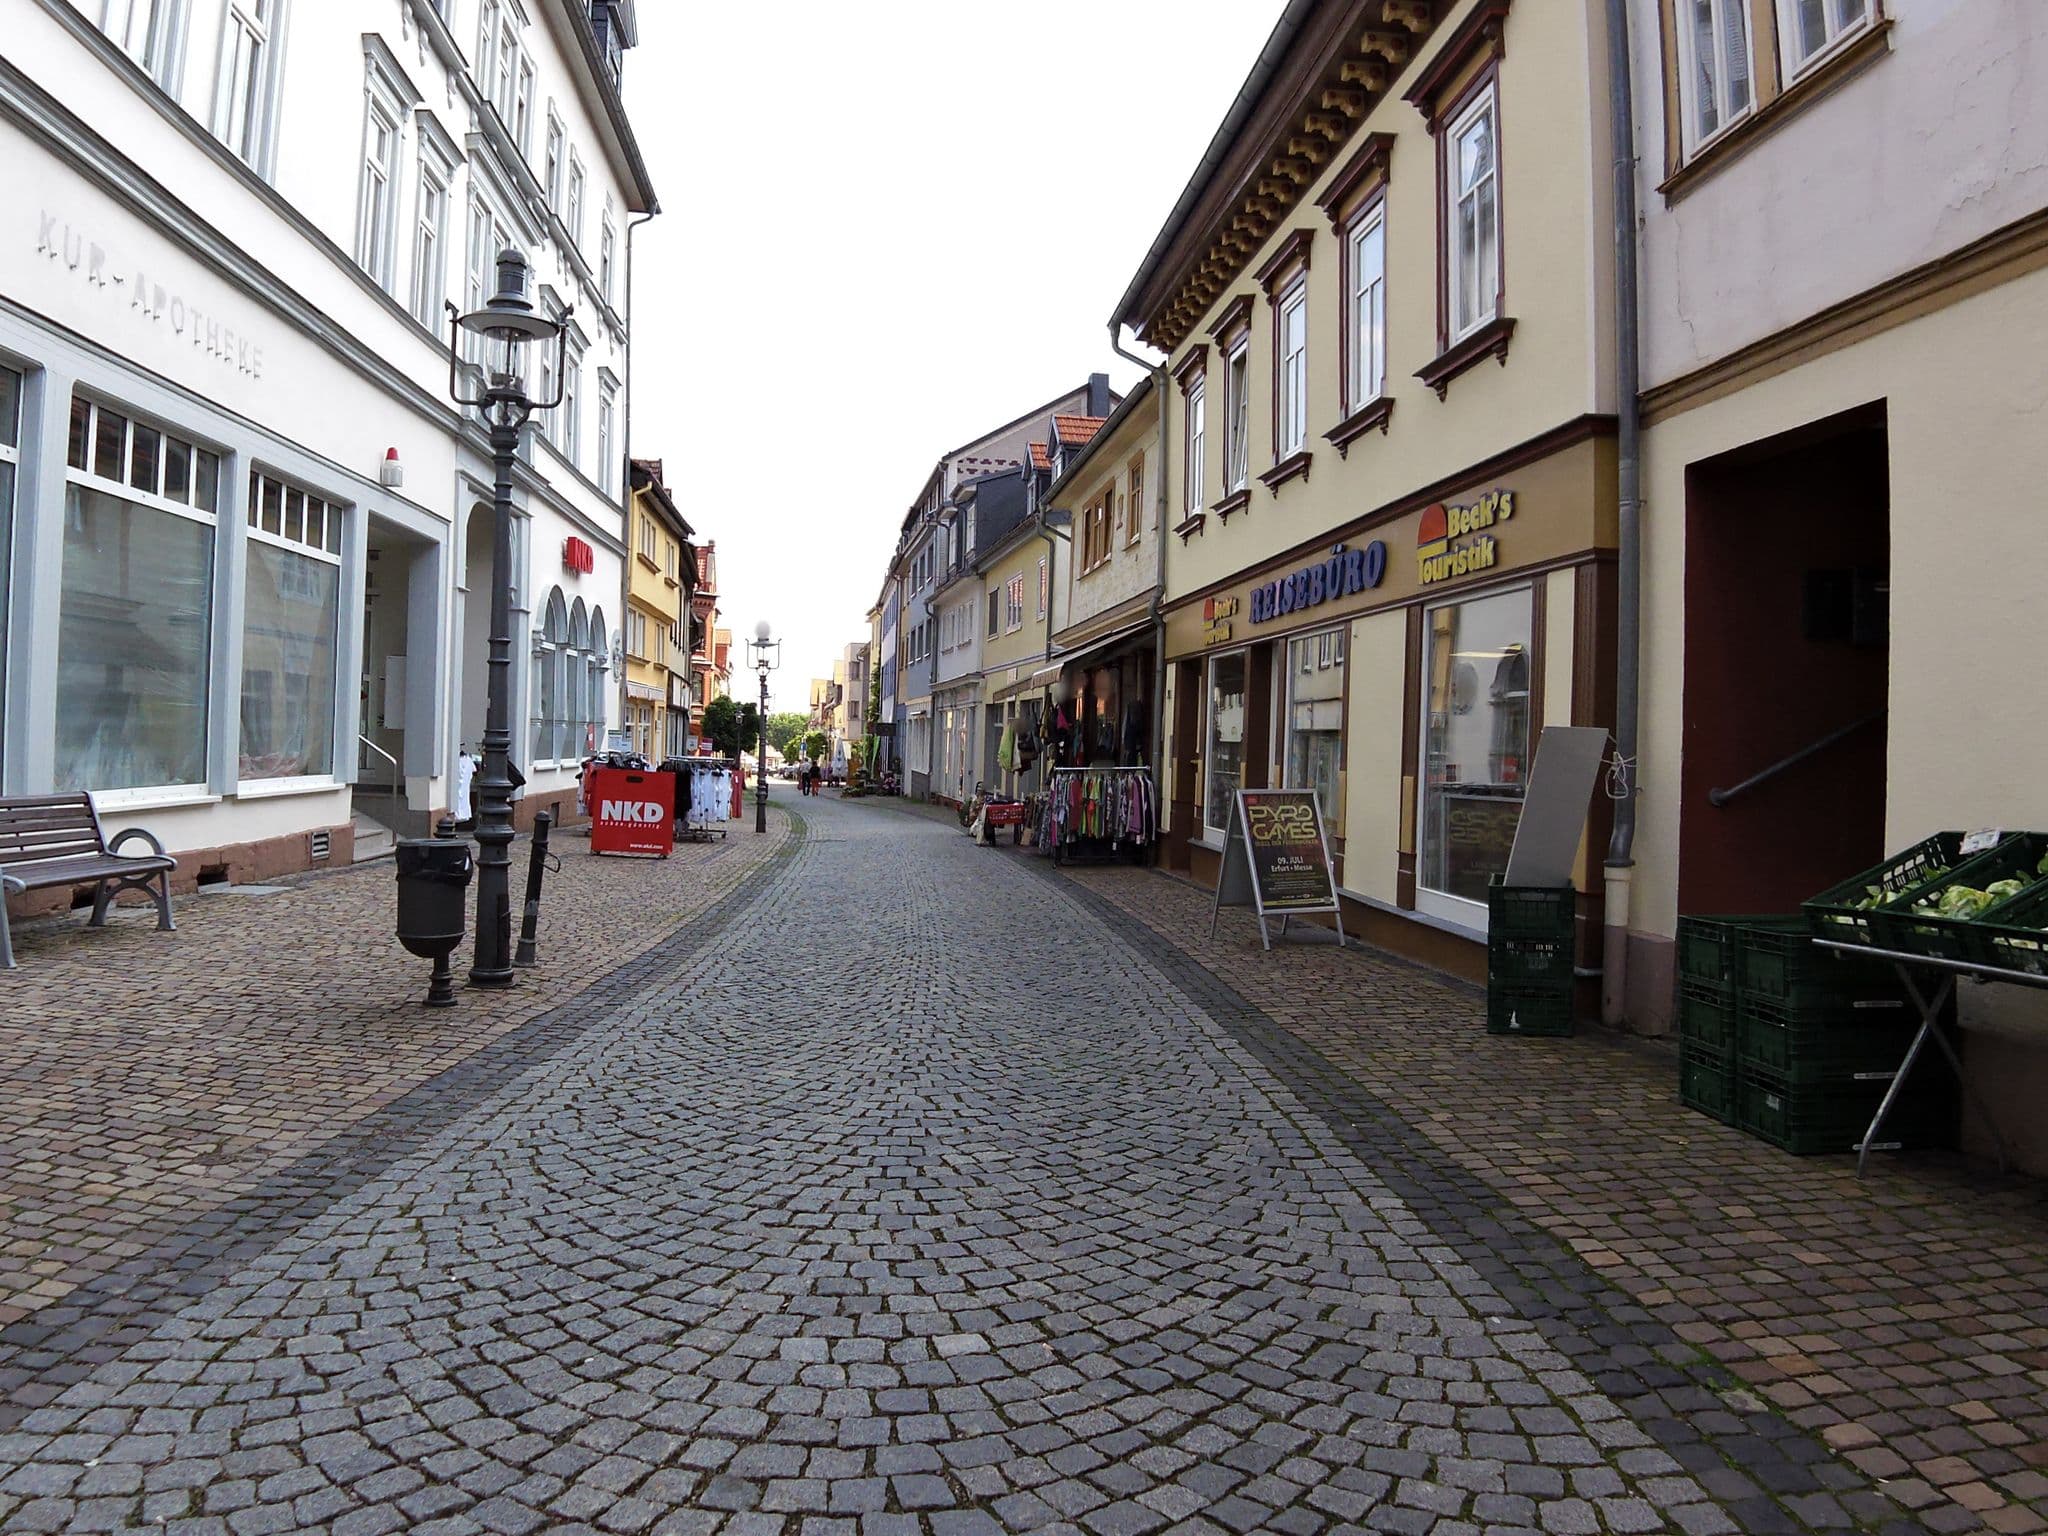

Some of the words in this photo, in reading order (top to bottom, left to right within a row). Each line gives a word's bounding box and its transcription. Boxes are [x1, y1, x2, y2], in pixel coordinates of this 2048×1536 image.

[1447, 491, 1512, 539] Beck's
[1417, 536, 1495, 585] Touristik
[1249, 540, 1387, 624] REISEBÜRO
[601, 799, 664, 823] NKD
[1248, 804, 1313, 822] PYRO
[1253, 822, 1317, 840] GAMES
[1271, 865, 1290, 873] Erfurt
